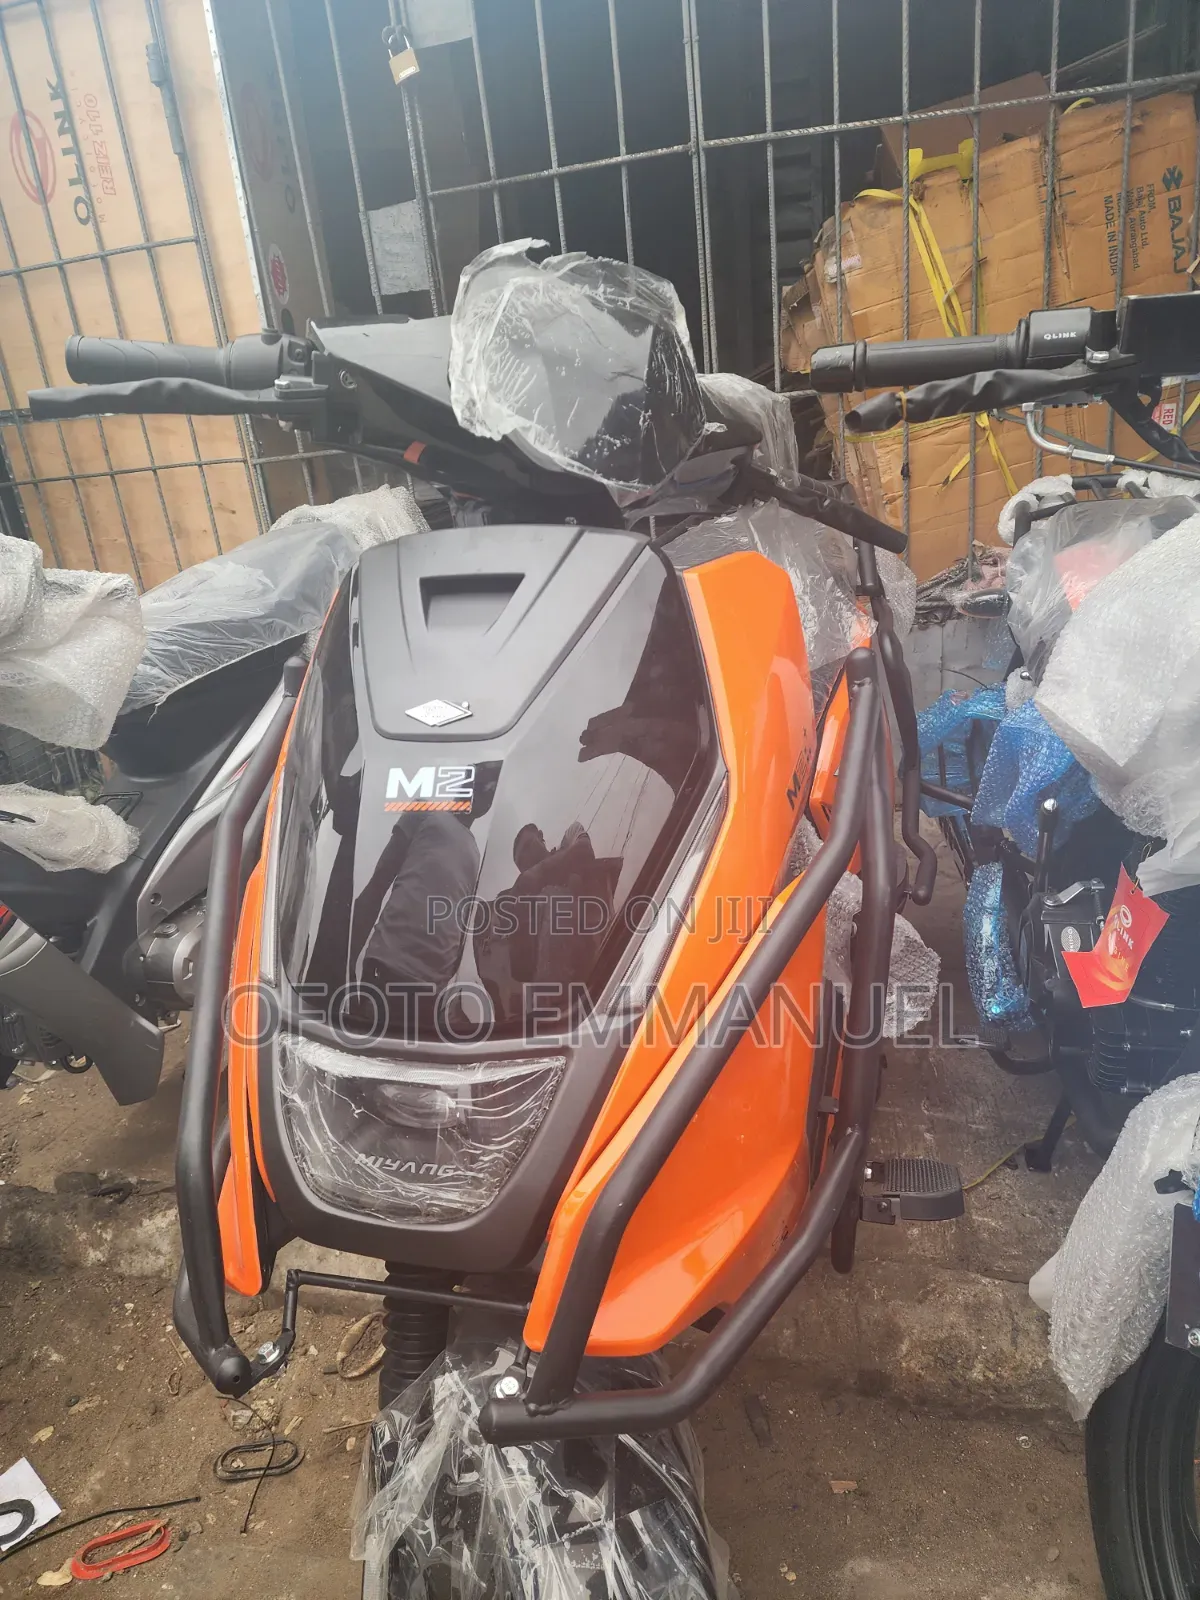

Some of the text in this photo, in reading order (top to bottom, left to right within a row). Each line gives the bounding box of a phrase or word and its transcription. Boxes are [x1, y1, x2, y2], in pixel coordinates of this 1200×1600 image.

[93, 140, 116, 195] REIZ
[1104, 195, 1119, 276] MADE IN INDIA
[1139, 210, 1147, 231] Auto
[1168, 195, 1188, 274] BAJAJ
[1043, 331, 1077, 341] QLINK
[1163, 408, 1174, 425] RED
[385, 766, 475, 798] M2
